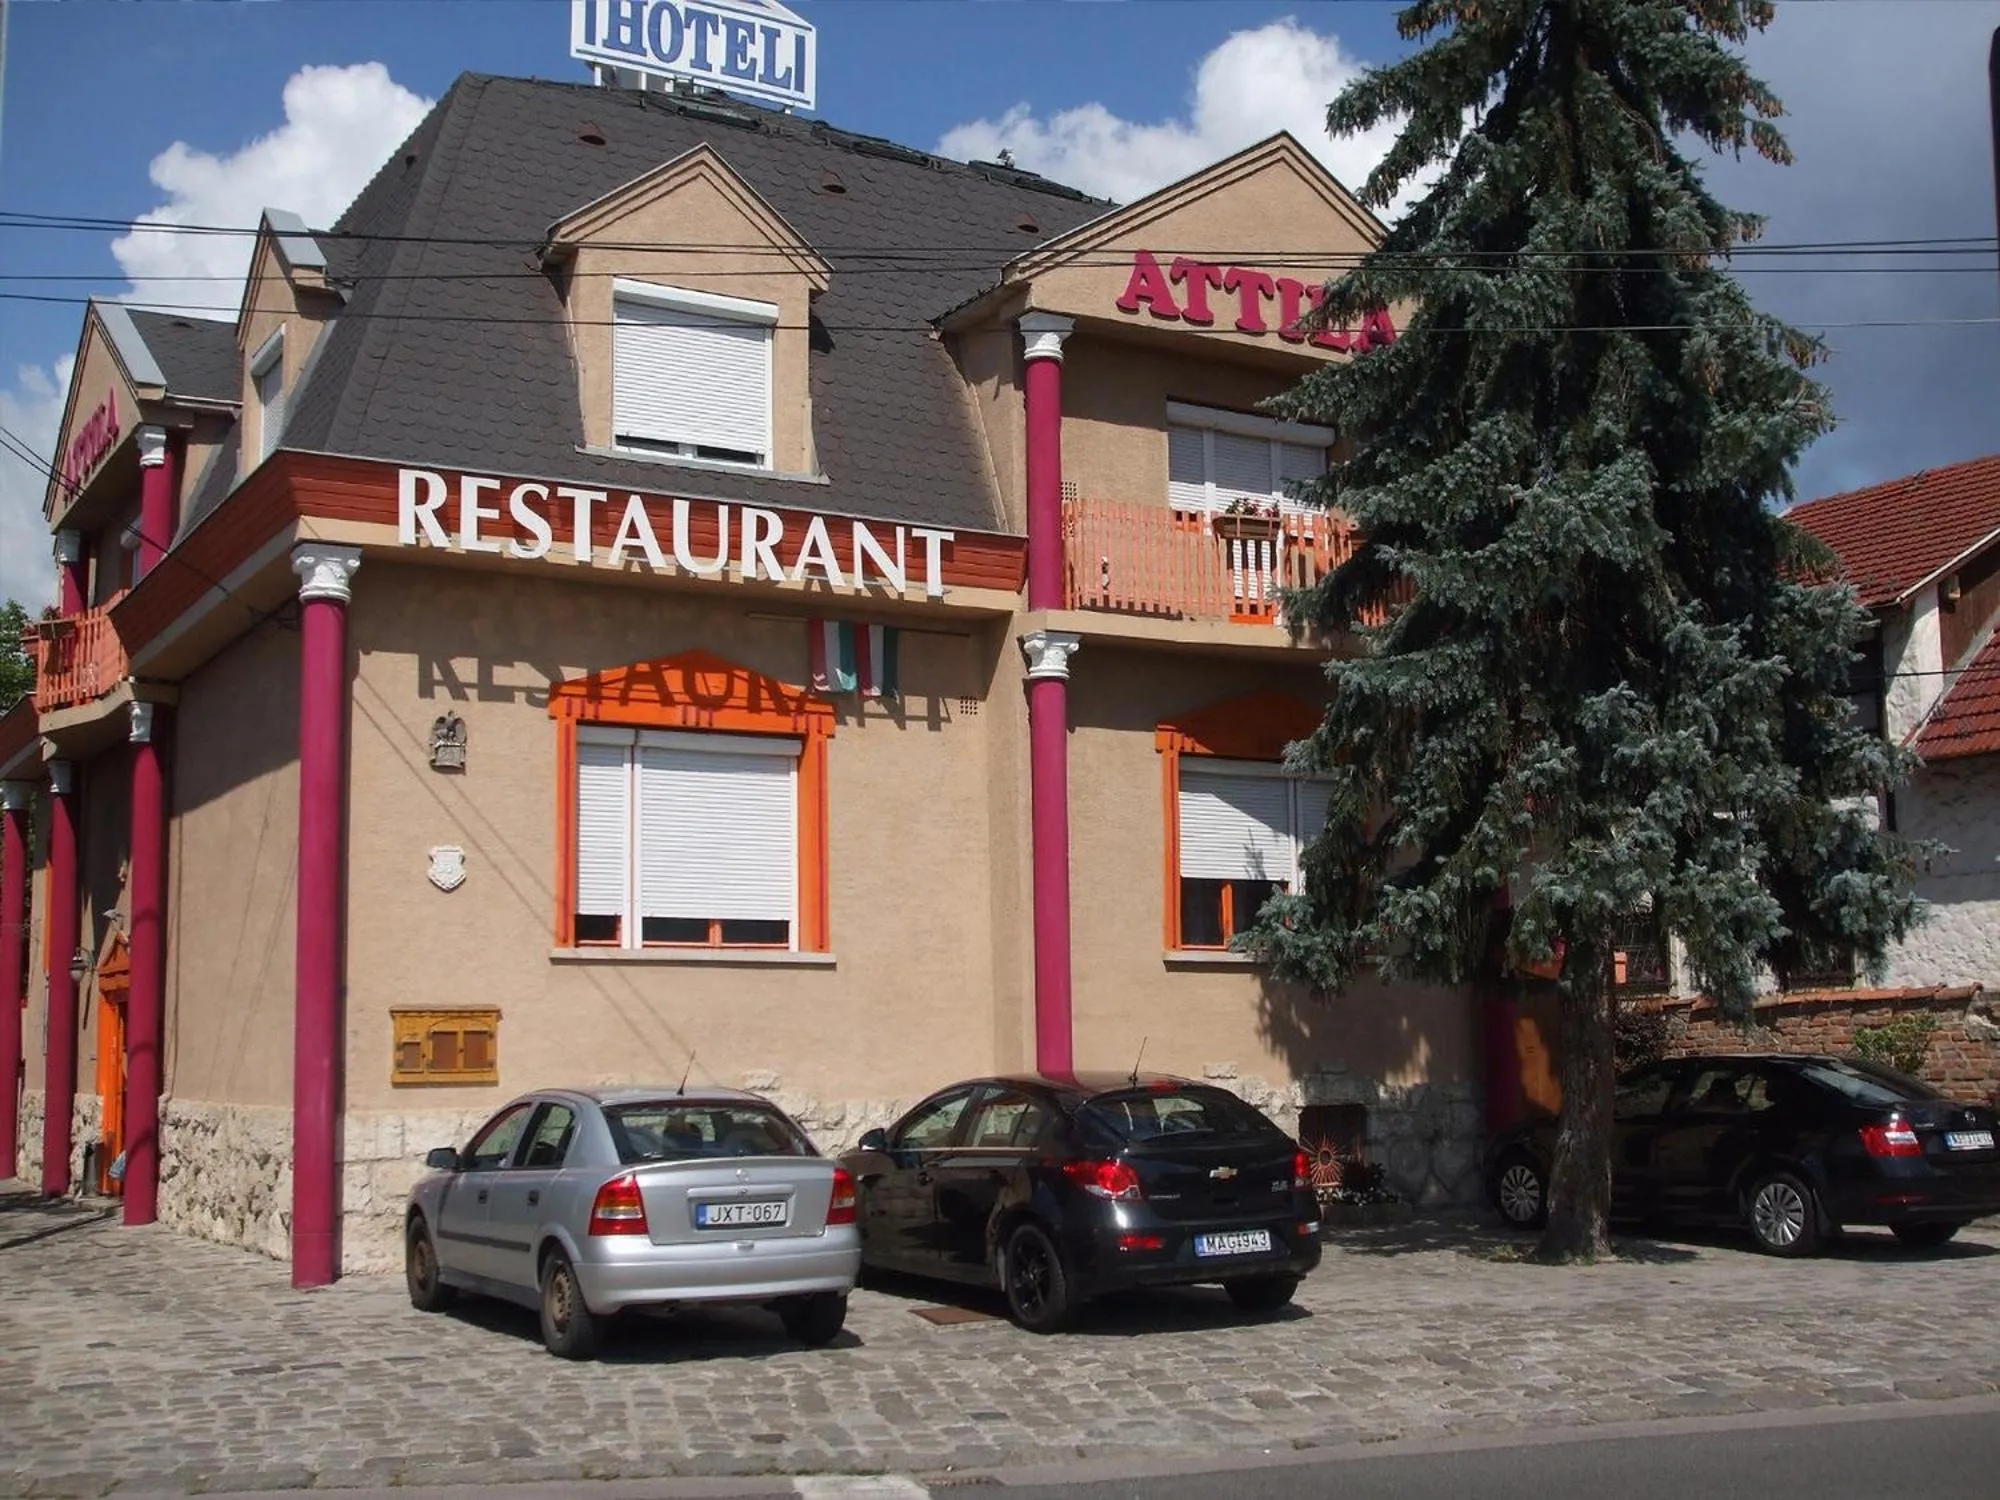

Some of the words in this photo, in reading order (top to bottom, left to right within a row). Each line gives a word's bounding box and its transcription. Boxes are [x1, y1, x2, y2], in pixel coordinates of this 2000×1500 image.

[602, 0, 792, 90] HOTEL
[397, 469, 954, 597] RESTAURANT
[711, 1204, 782, 1223] JXT-067
